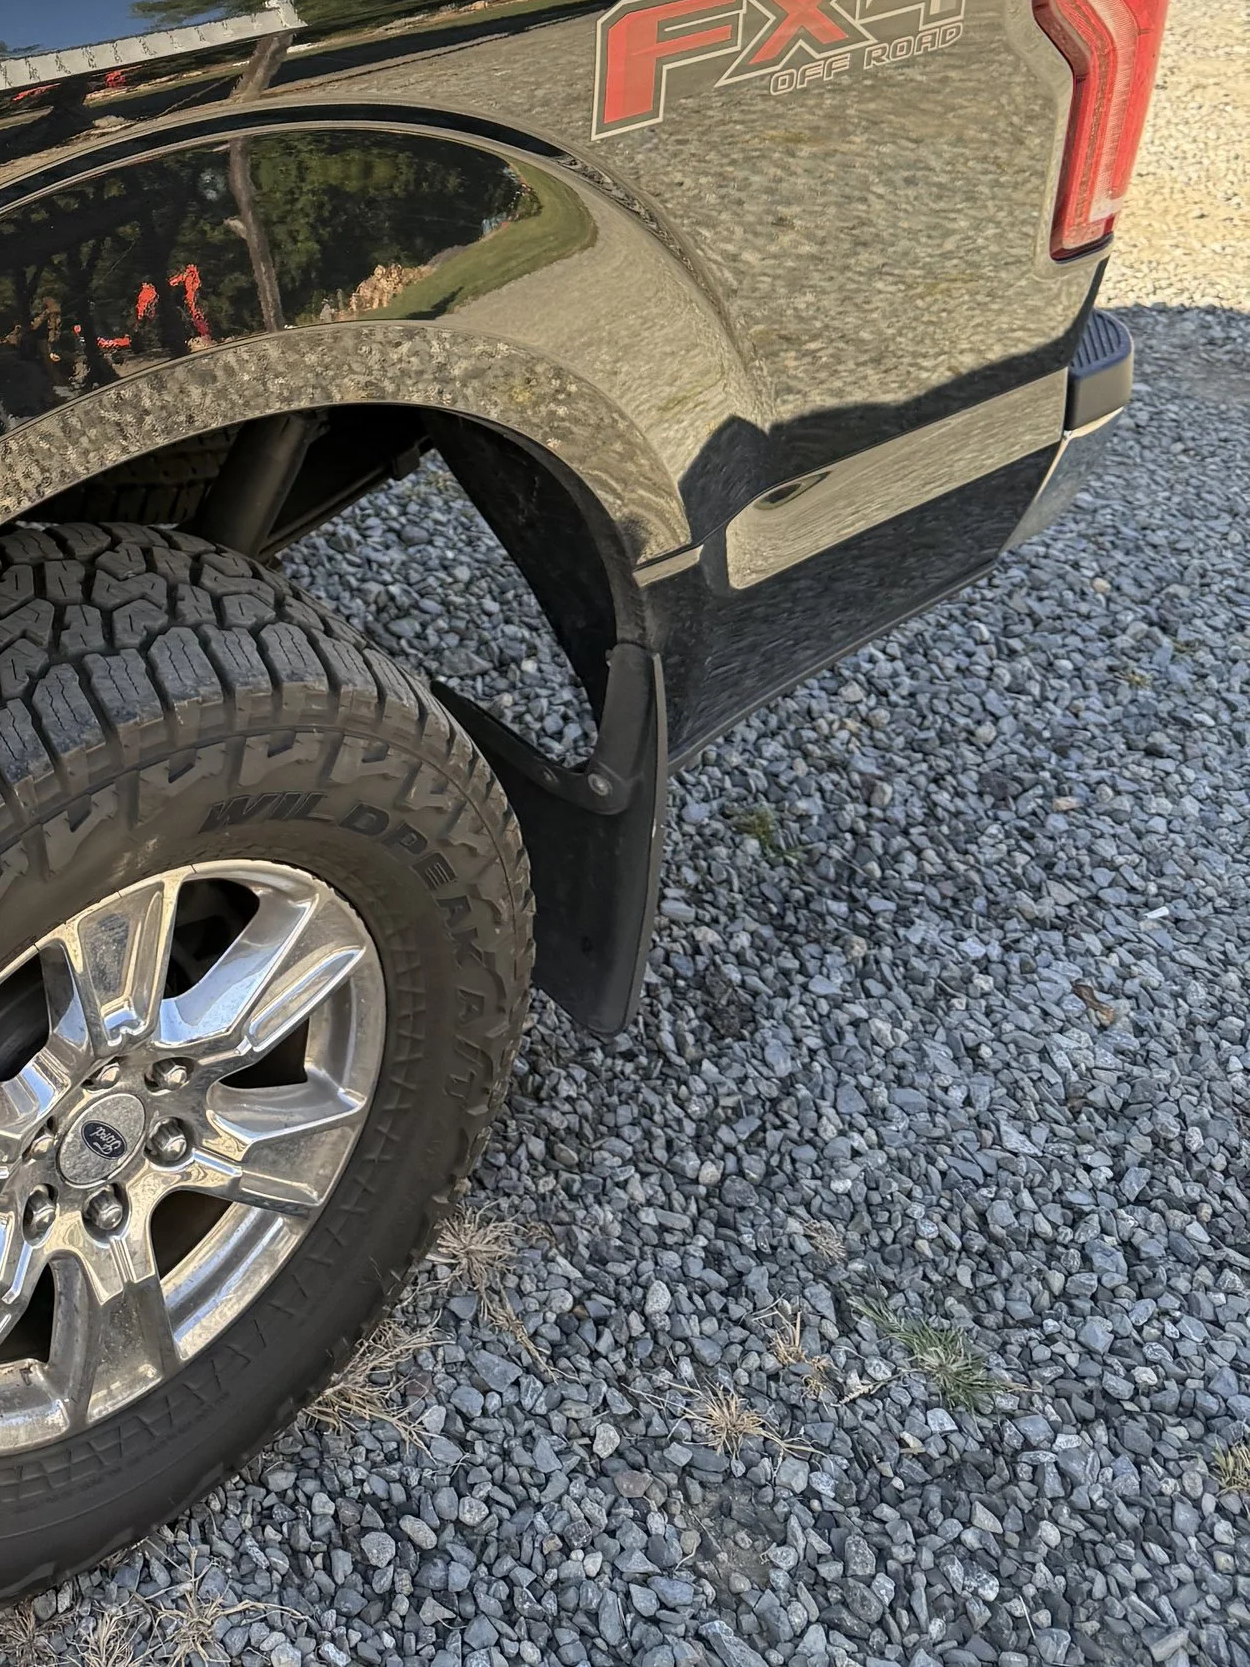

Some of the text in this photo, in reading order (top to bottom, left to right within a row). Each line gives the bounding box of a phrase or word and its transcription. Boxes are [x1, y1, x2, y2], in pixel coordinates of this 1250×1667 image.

[768, 21, 964, 96] OFF ROAD
[197, 791, 486, 969] WILDPEAK
[89, 1126, 122, 1155] Ford
